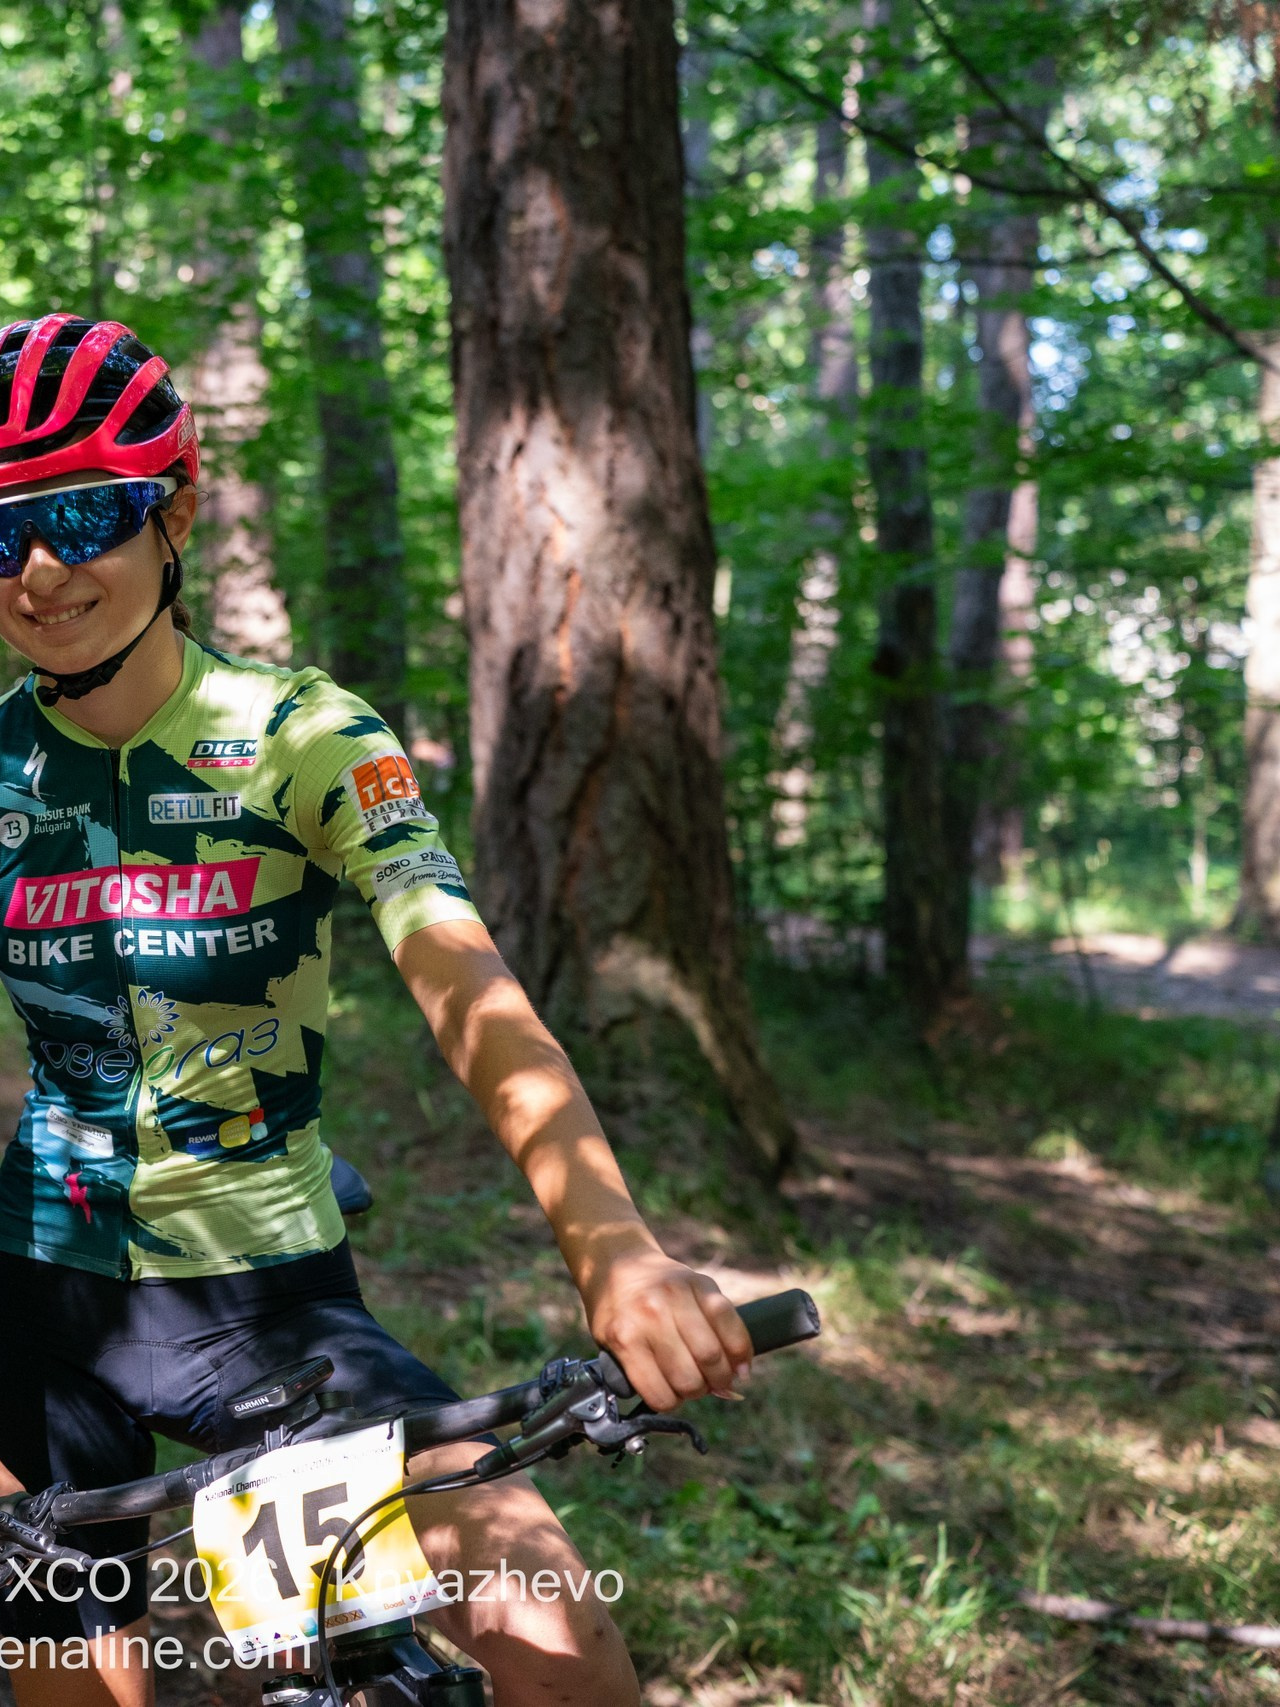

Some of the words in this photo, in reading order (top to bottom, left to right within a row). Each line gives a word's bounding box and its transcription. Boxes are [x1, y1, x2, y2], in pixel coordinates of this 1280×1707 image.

[194, 740, 258, 757] DIEM
[192, 758, 256, 768] SPORT
[35, 807, 65, 824] TISSUE
[66, 802, 92, 818] BANK
[363, 800, 402, 820] TRADE
[34, 820, 72, 836] Bulgaria
[376, 858, 411, 883] SONO
[404, 871, 438, 889] Aroma
[25, 869, 239, 925] VITOSHA
[7, 934, 95, 967] BIKE
[113, 917, 279, 958] CENTER
[188, 1132, 218, 1144] REWAY
[234, 1396, 270, 1412] GARMIN
[242, 1482, 366, 1601] 15
